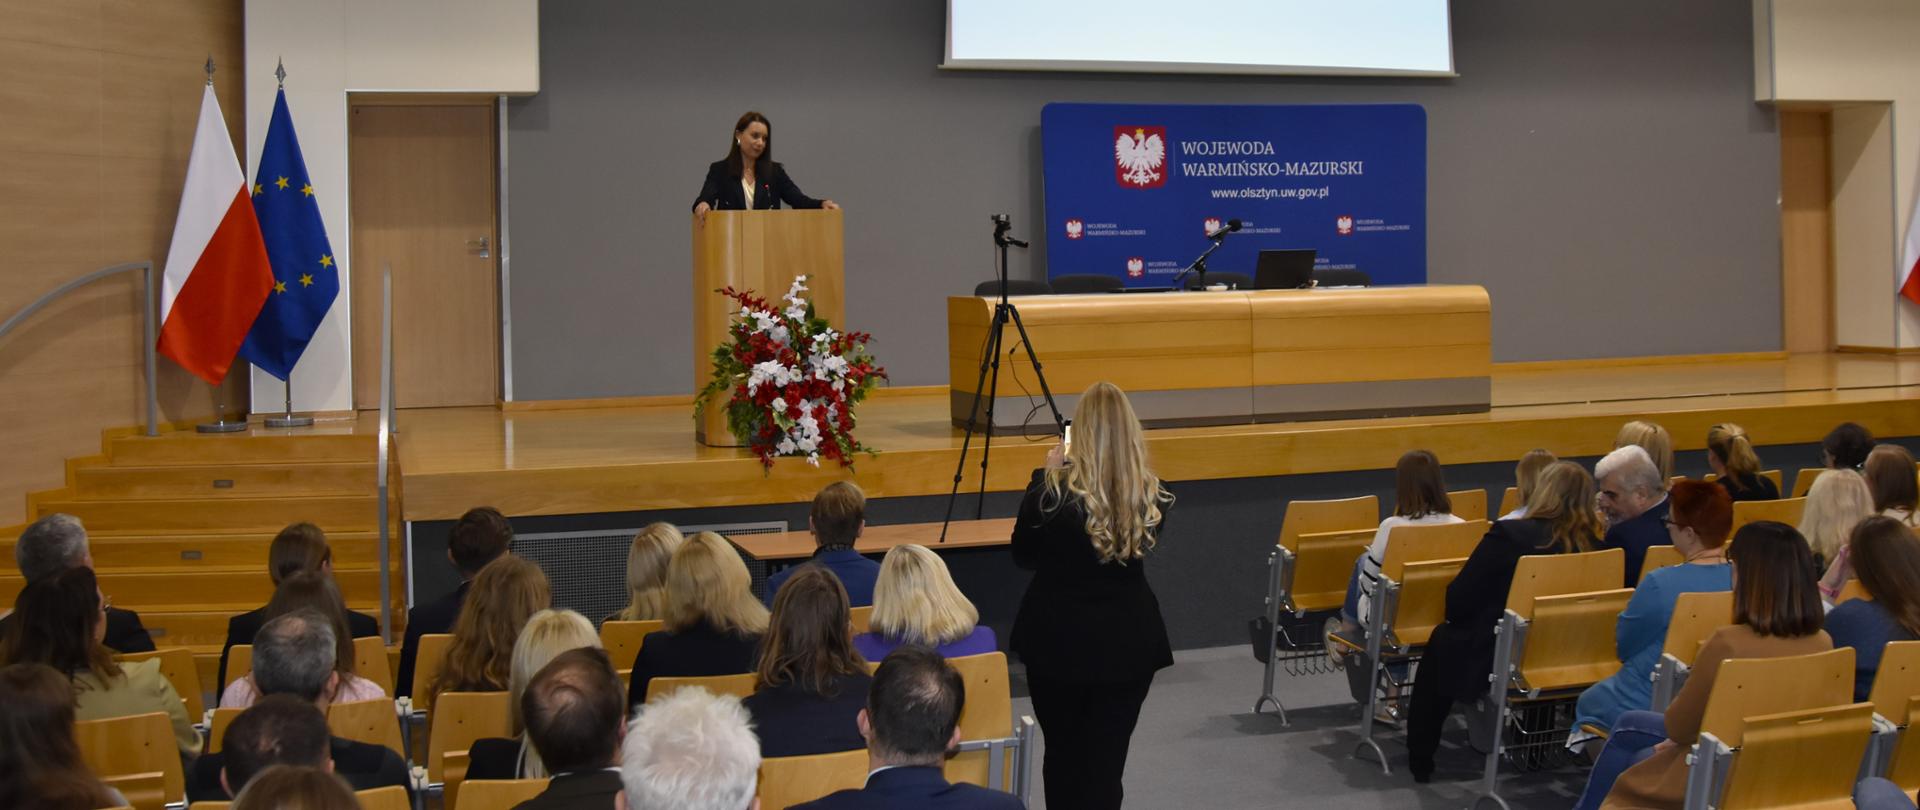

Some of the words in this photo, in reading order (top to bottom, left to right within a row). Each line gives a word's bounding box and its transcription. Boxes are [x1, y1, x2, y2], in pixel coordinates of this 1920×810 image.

[1181, 141, 1275, 155] WOJEWODA
[1182, 160, 1363, 176] WARMIŃSKO-MAZURSKI
[1211, 186, 1329, 200] www.olsztyn.uw.gov.pl
